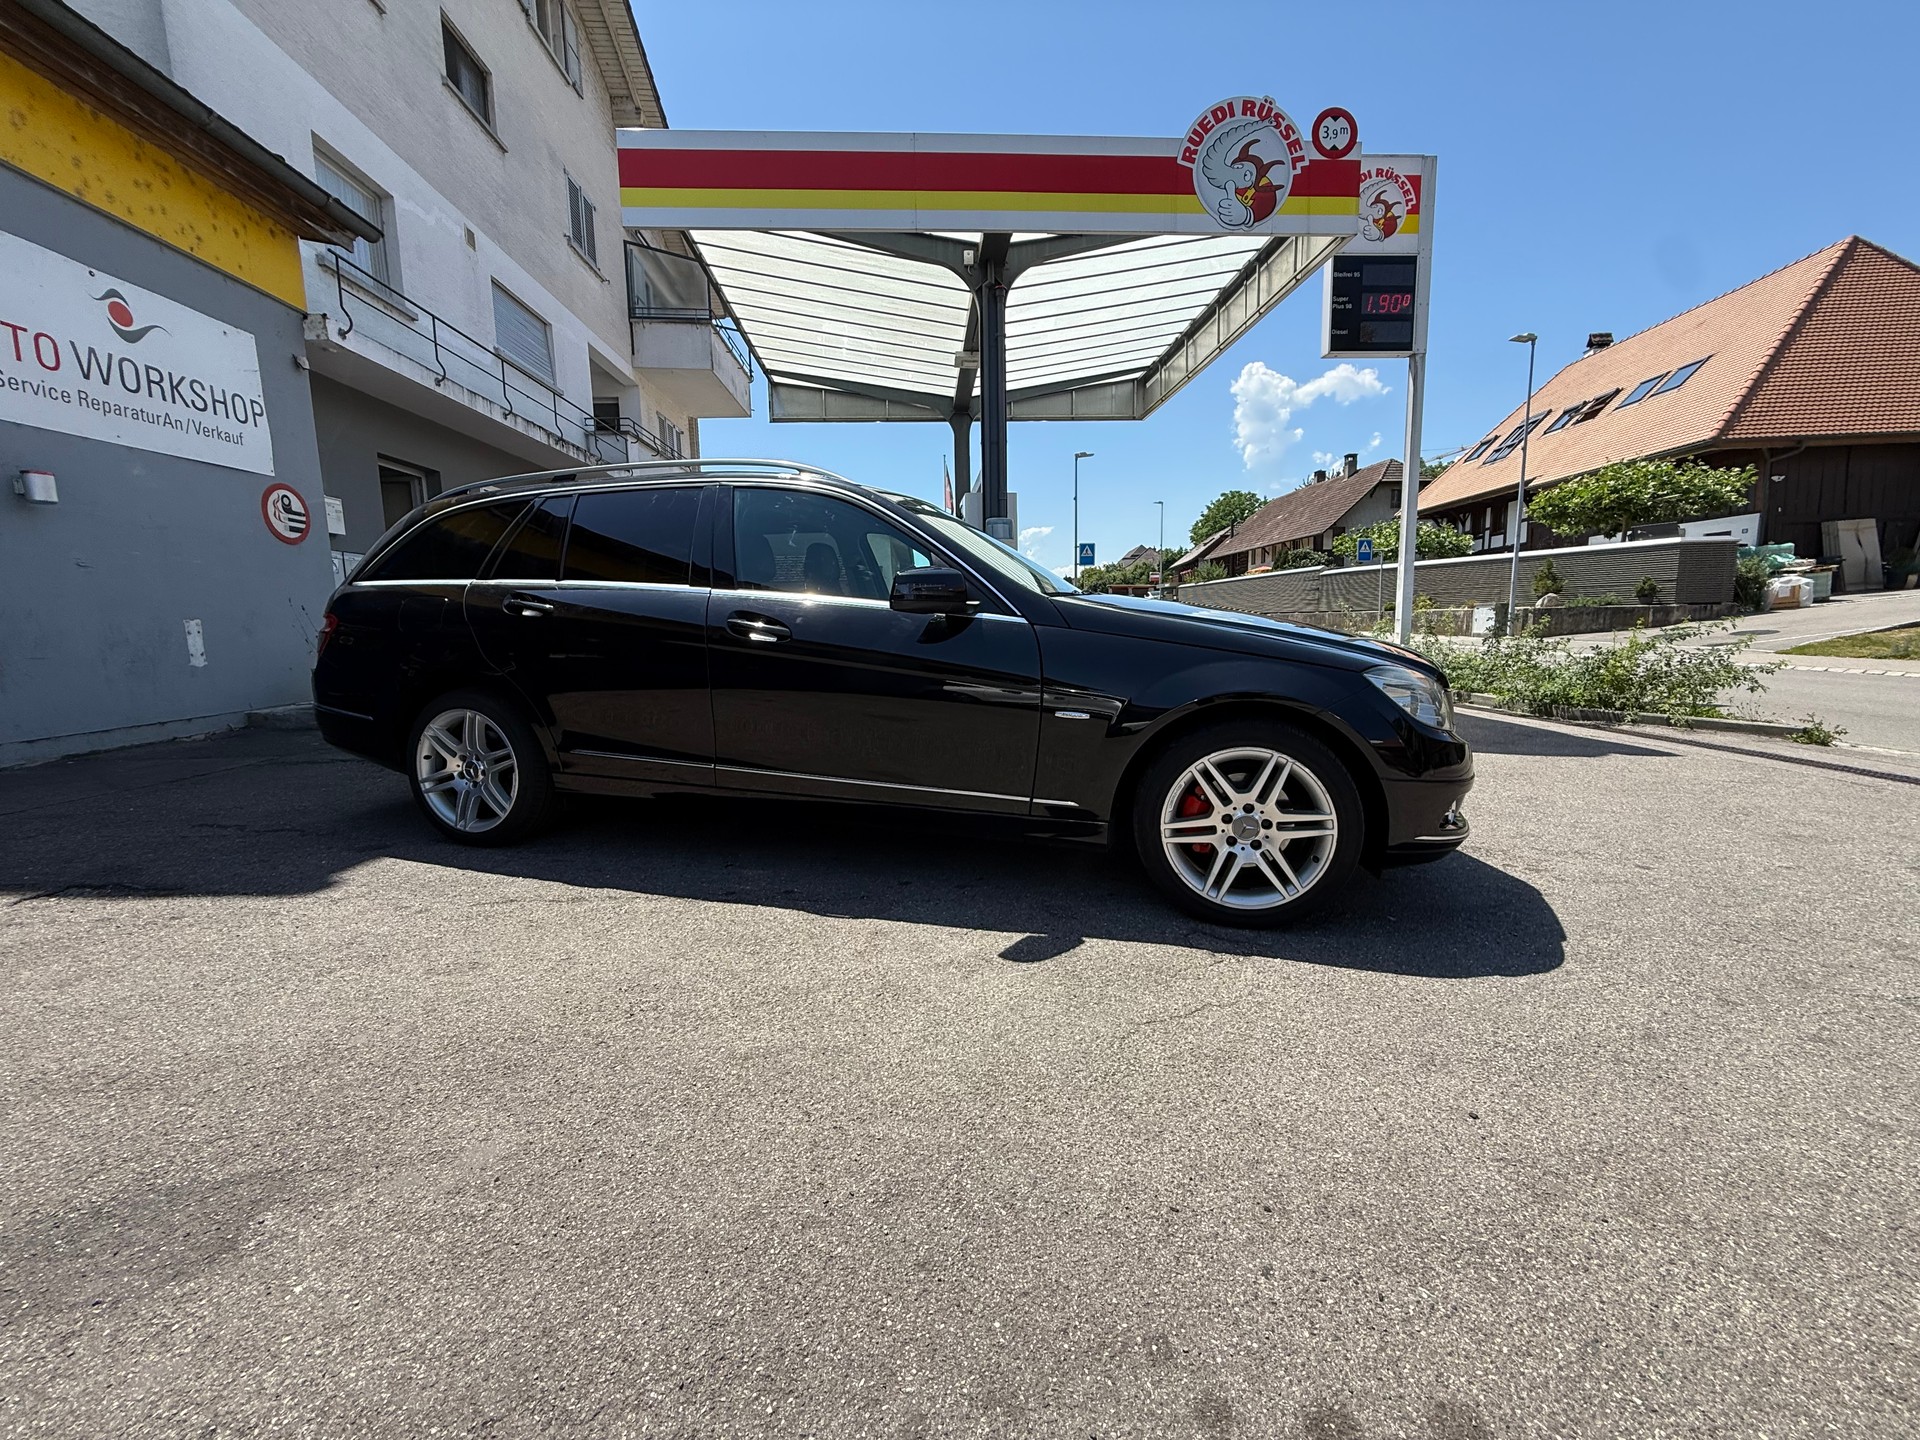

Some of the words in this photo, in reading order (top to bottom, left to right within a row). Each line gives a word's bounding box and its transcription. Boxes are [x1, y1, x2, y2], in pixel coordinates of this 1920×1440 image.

[1181, 101, 1236, 165] RUEDI
[1241, 98, 1306, 171] RÜSSEL
[1375, 166, 1414, 208] RÜSSEL
[69, 340, 265, 428] WORKSHOP
